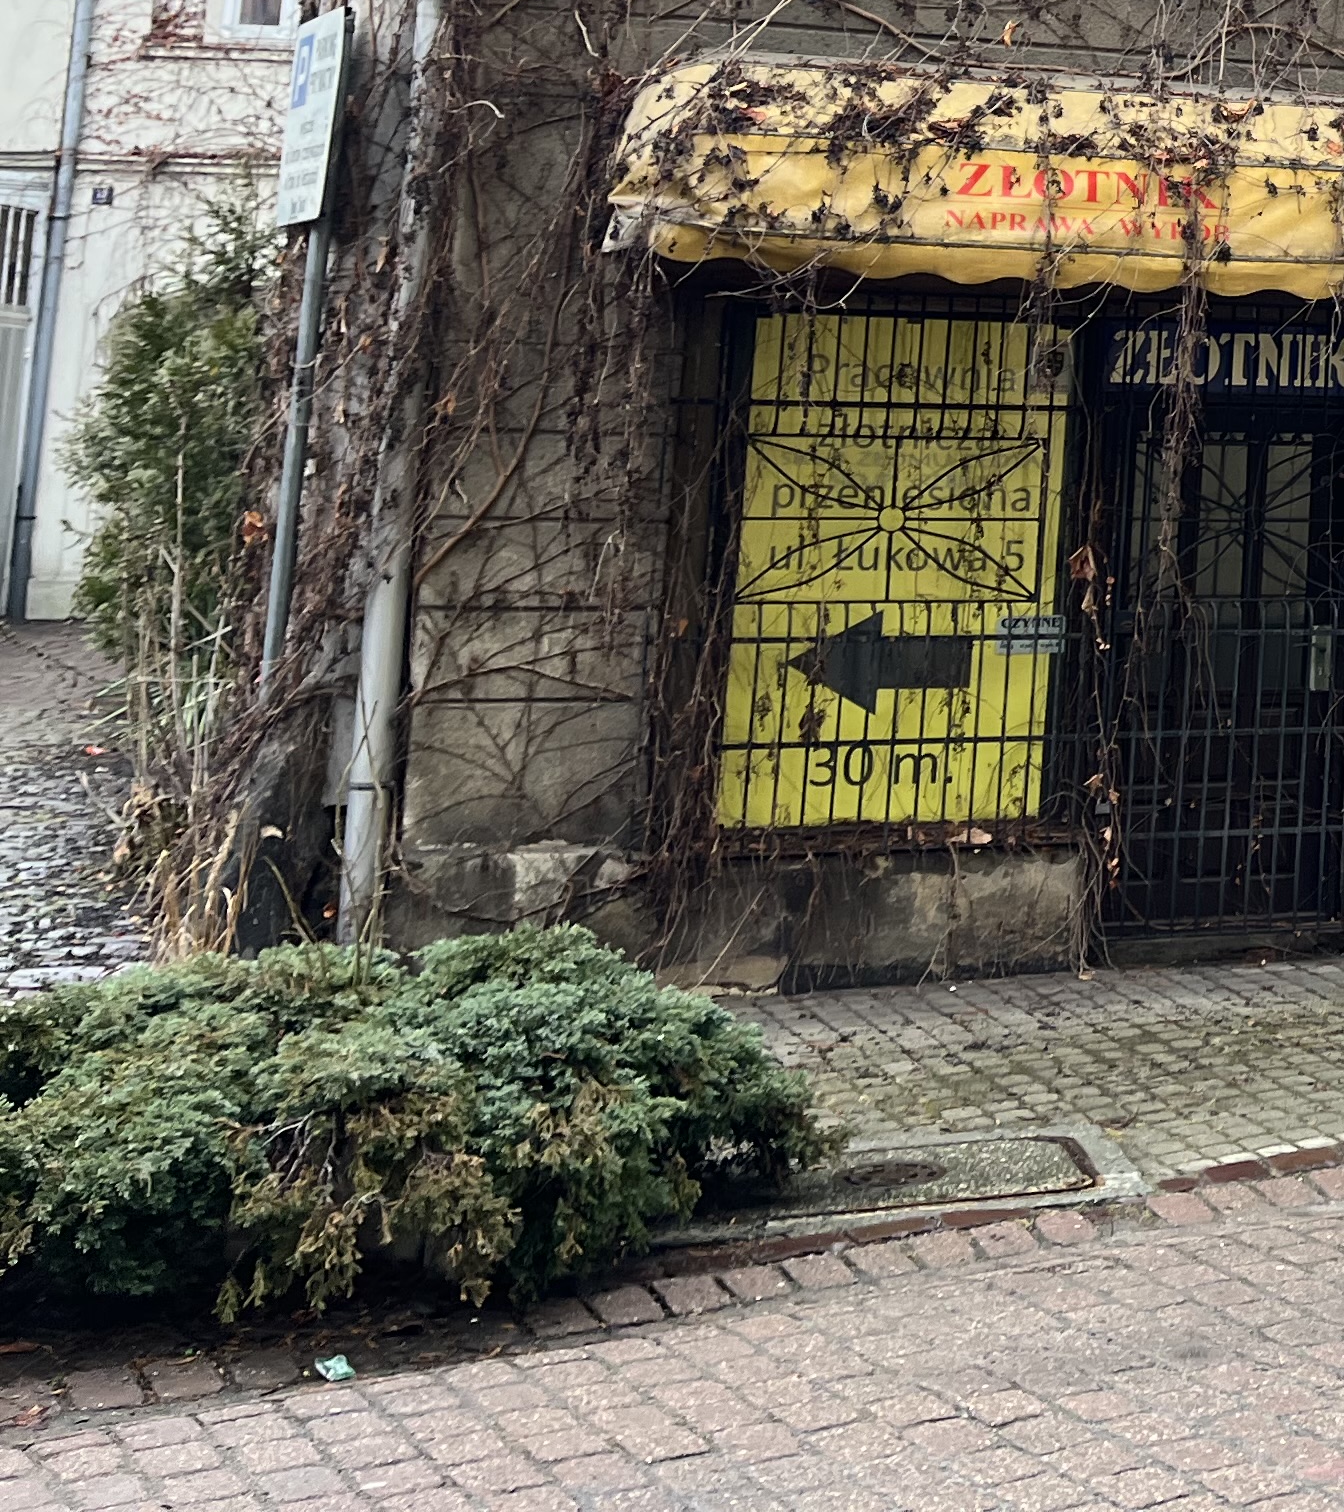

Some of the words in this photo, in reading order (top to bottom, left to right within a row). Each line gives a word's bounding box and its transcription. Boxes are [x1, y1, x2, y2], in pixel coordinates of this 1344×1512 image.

[945, 209, 1096, 236] NAPRAWA
[773, 480, 1031, 517] przenesiona
[832, 538, 987, 573] Łukowa
[1006, 540, 1025, 571] 5
[809, 744, 873, 786] 30
